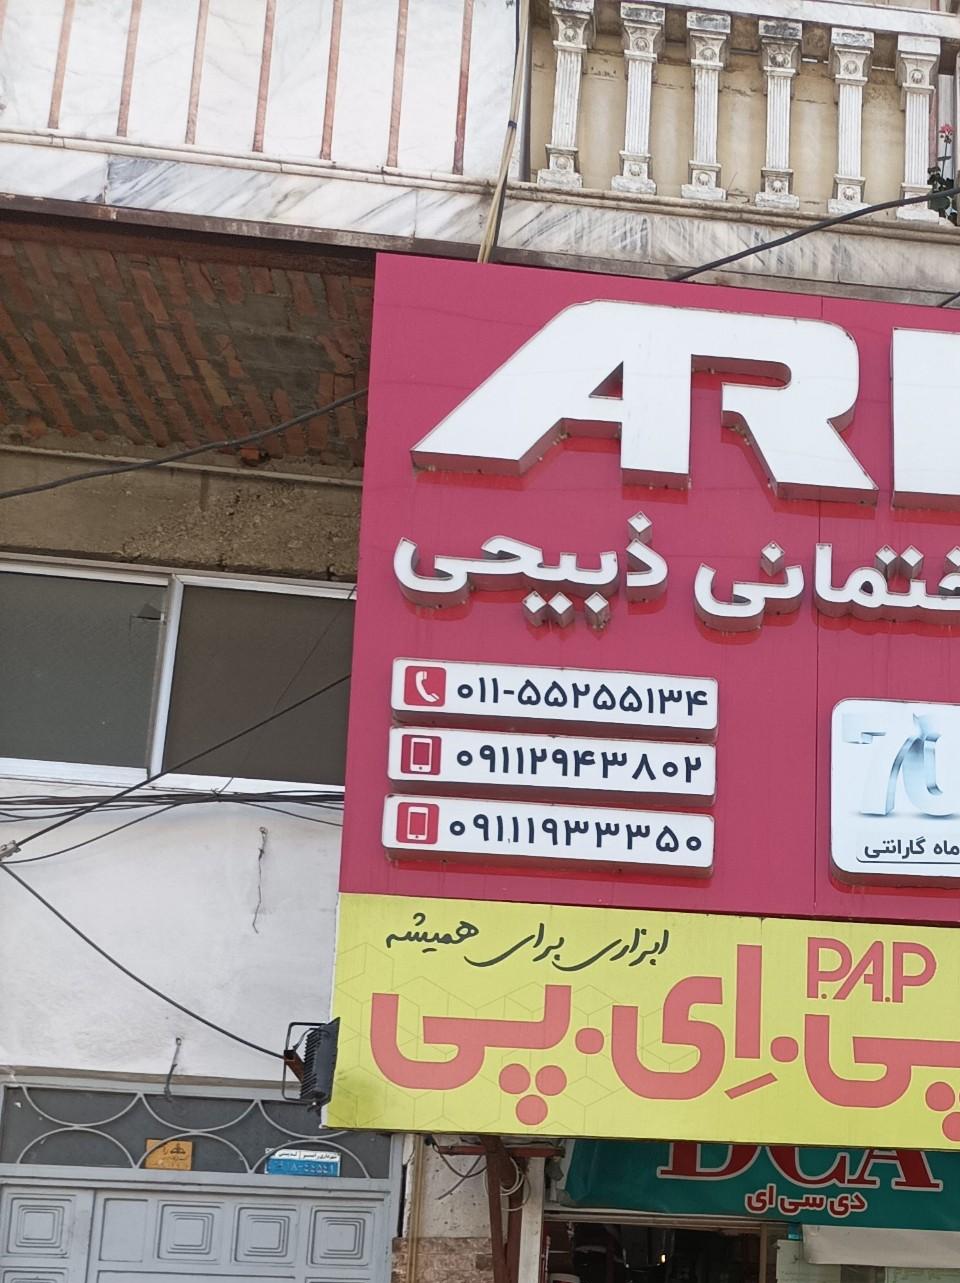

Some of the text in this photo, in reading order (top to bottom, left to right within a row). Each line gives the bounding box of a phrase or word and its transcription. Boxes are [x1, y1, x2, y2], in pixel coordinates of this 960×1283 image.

[393, 512, 669, 627] ذبیحی
[456, 678, 709, 716] ۰۱۱-۵۵۲۵۵۱۳۴
[456, 744, 702, 783] ۰۹۱۱۲۹۴۳۸۰۲
[449, 812, 702, 853] ۰۹۱۱۱۹۳۳۳۵۰
[864, 836, 960, 859] ماه گارانتی
[385, 912, 479, 953] همیشه
[464, 923, 564, 968] برای
[745, 1184, 867, 1217] دی سی ای
